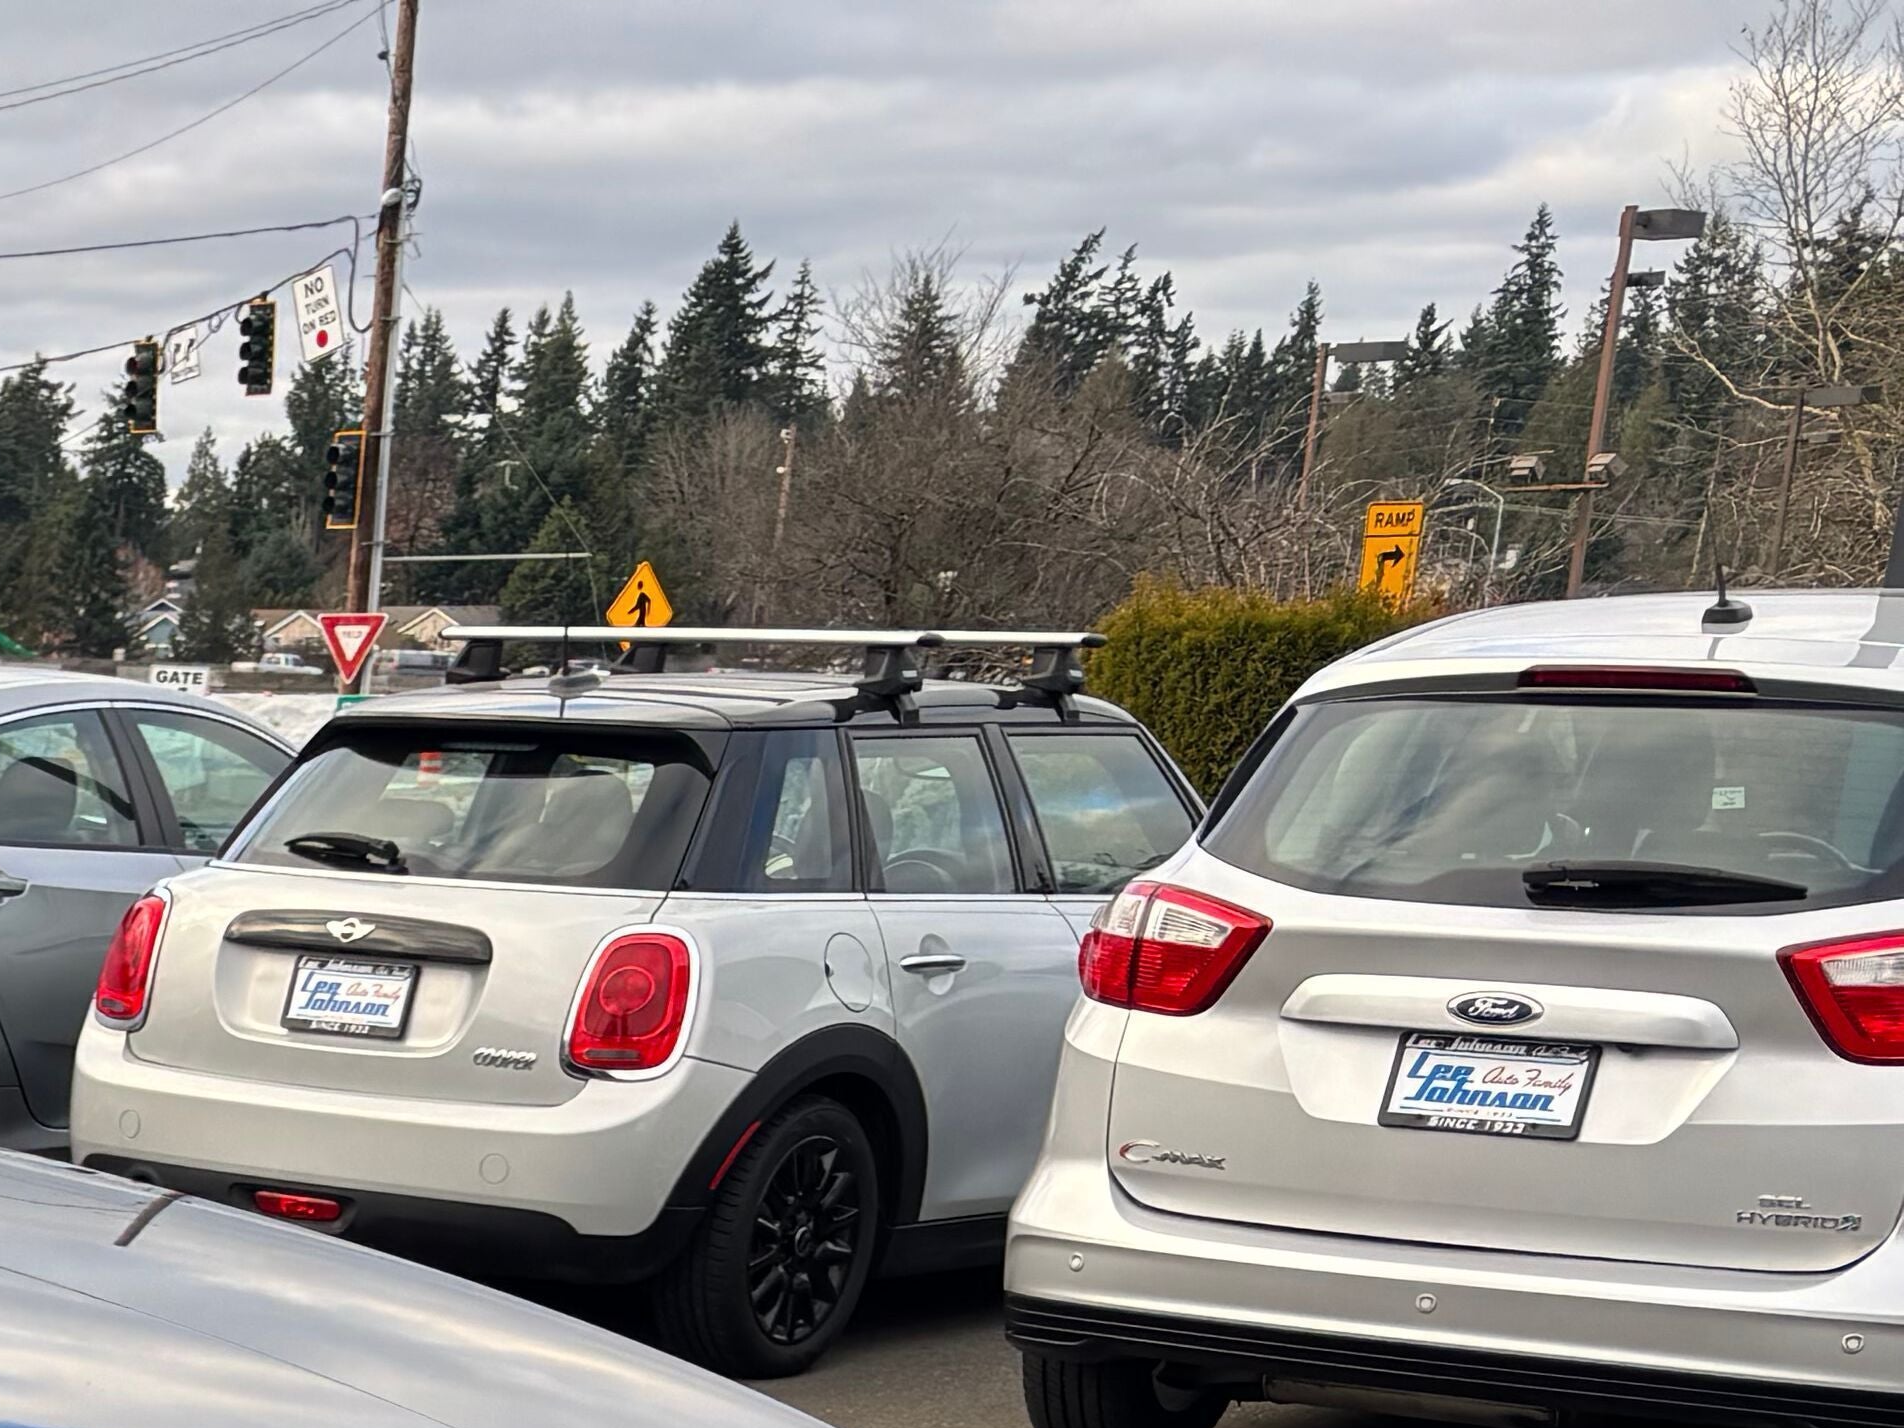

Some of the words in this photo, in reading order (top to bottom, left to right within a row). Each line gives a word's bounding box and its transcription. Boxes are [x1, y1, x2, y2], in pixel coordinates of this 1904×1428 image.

[304, 276, 324, 298] NO
[305, 295, 330, 315] TURN
[1375, 509, 1415, 528] RAMP
[156, 670, 204, 685] GATE
[300, 971, 342, 996] Lee
[298, 991, 390, 1017] Johnson
[1467, 996, 1520, 1020] Ford
[473, 1047, 537, 1071] COOPER
[1407, 1051, 1475, 1083] Lee
[1482, 1066, 1519, 1085] Auto
[1522, 1068, 1574, 1097] Family
[1403, 1075, 1555, 1112] Johnson
[1427, 1116, 1478, 1130] SINCE
[1485, 1121, 1525, 1134] 1933
[1736, 1210, 1840, 1230] HYBRID
